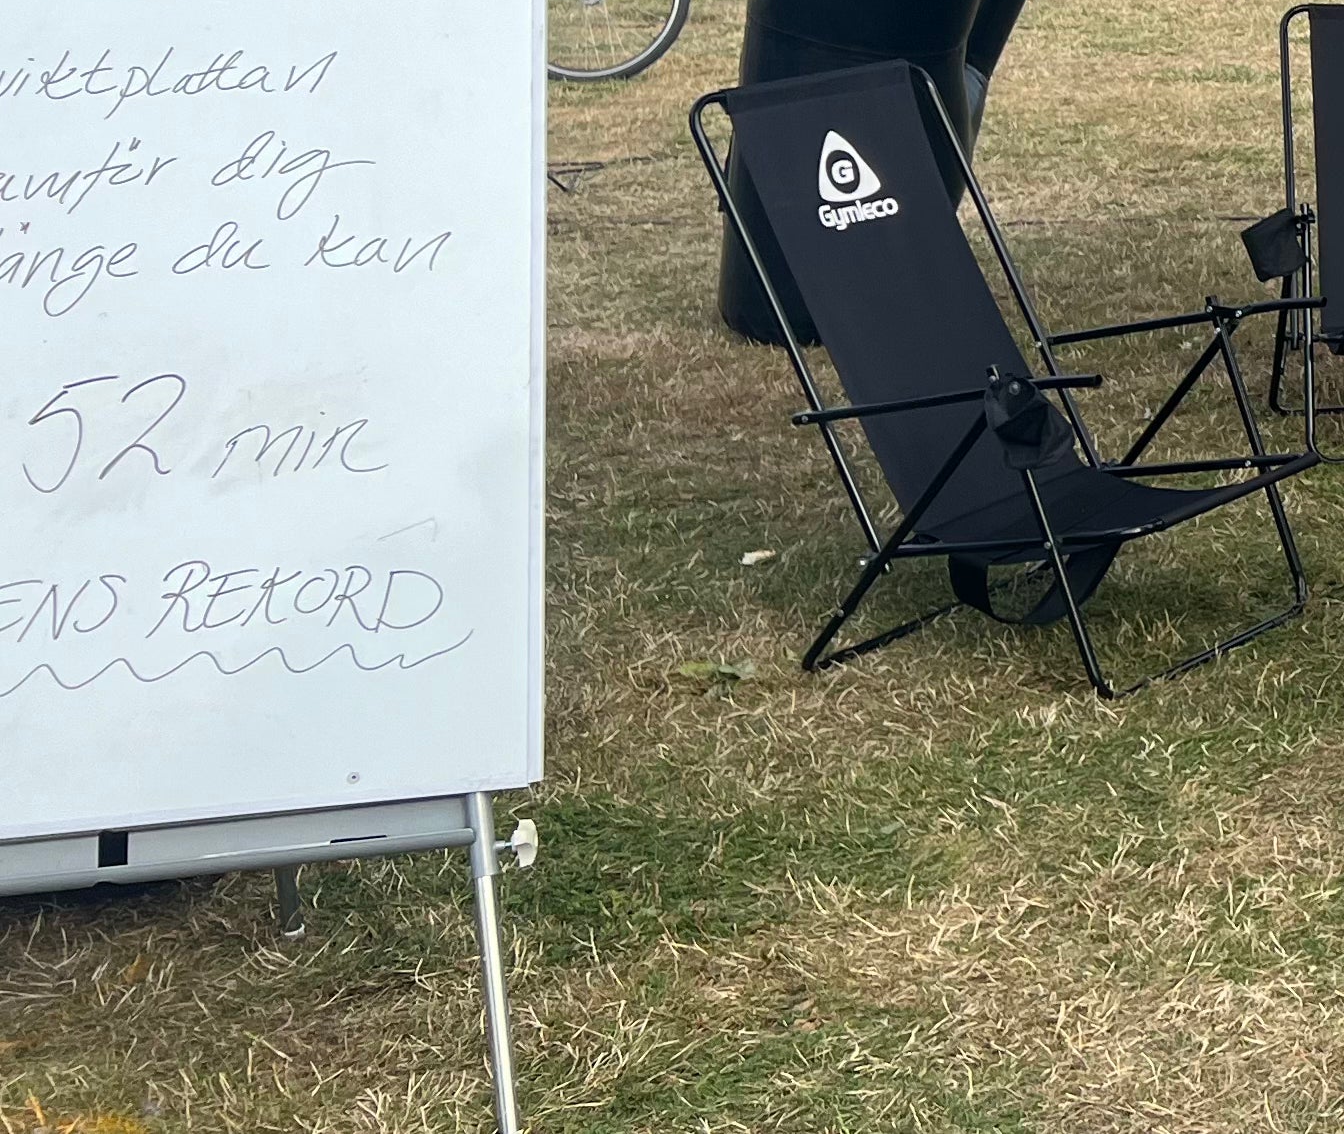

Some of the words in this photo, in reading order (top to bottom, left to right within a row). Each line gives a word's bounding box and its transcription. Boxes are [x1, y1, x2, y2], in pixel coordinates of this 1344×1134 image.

[211, 131, 376, 220] dig
[818, 197, 899, 230] Gymleco
[172, 222, 270, 275] du
[305, 216, 452, 273] kan
[22, 373, 187, 493] 52
[212, 411, 389, 478] min
[145, 560, 443, 639] REKORD
